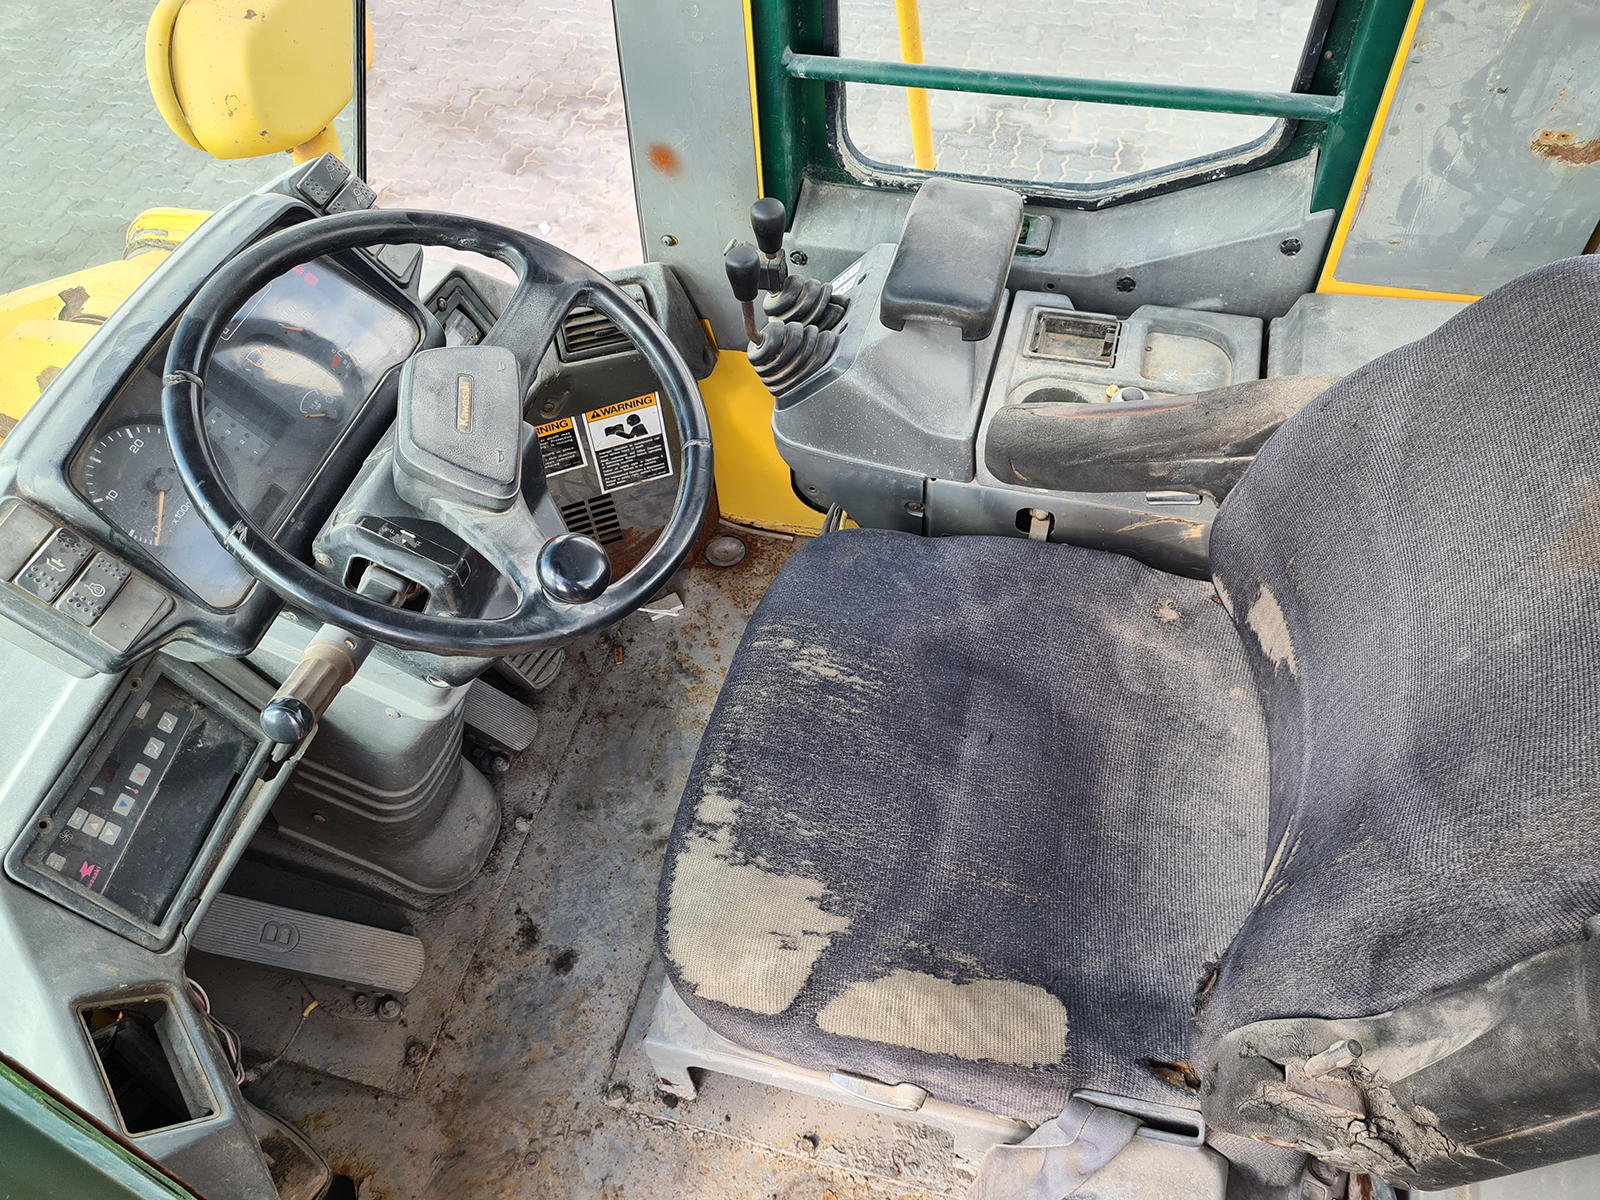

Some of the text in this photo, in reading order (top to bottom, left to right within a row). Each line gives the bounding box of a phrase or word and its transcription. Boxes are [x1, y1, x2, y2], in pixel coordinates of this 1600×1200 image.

[459, 381, 471, 427] Kawasaki
[600, 396, 653, 416] WARNING
[536, 419, 569, 435] RNING
[129, 438, 145, 454] 20
[105, 489, 119, 502] 10
[88, 866, 101, 889] wasaki
[260, 921, 295, 947] B
